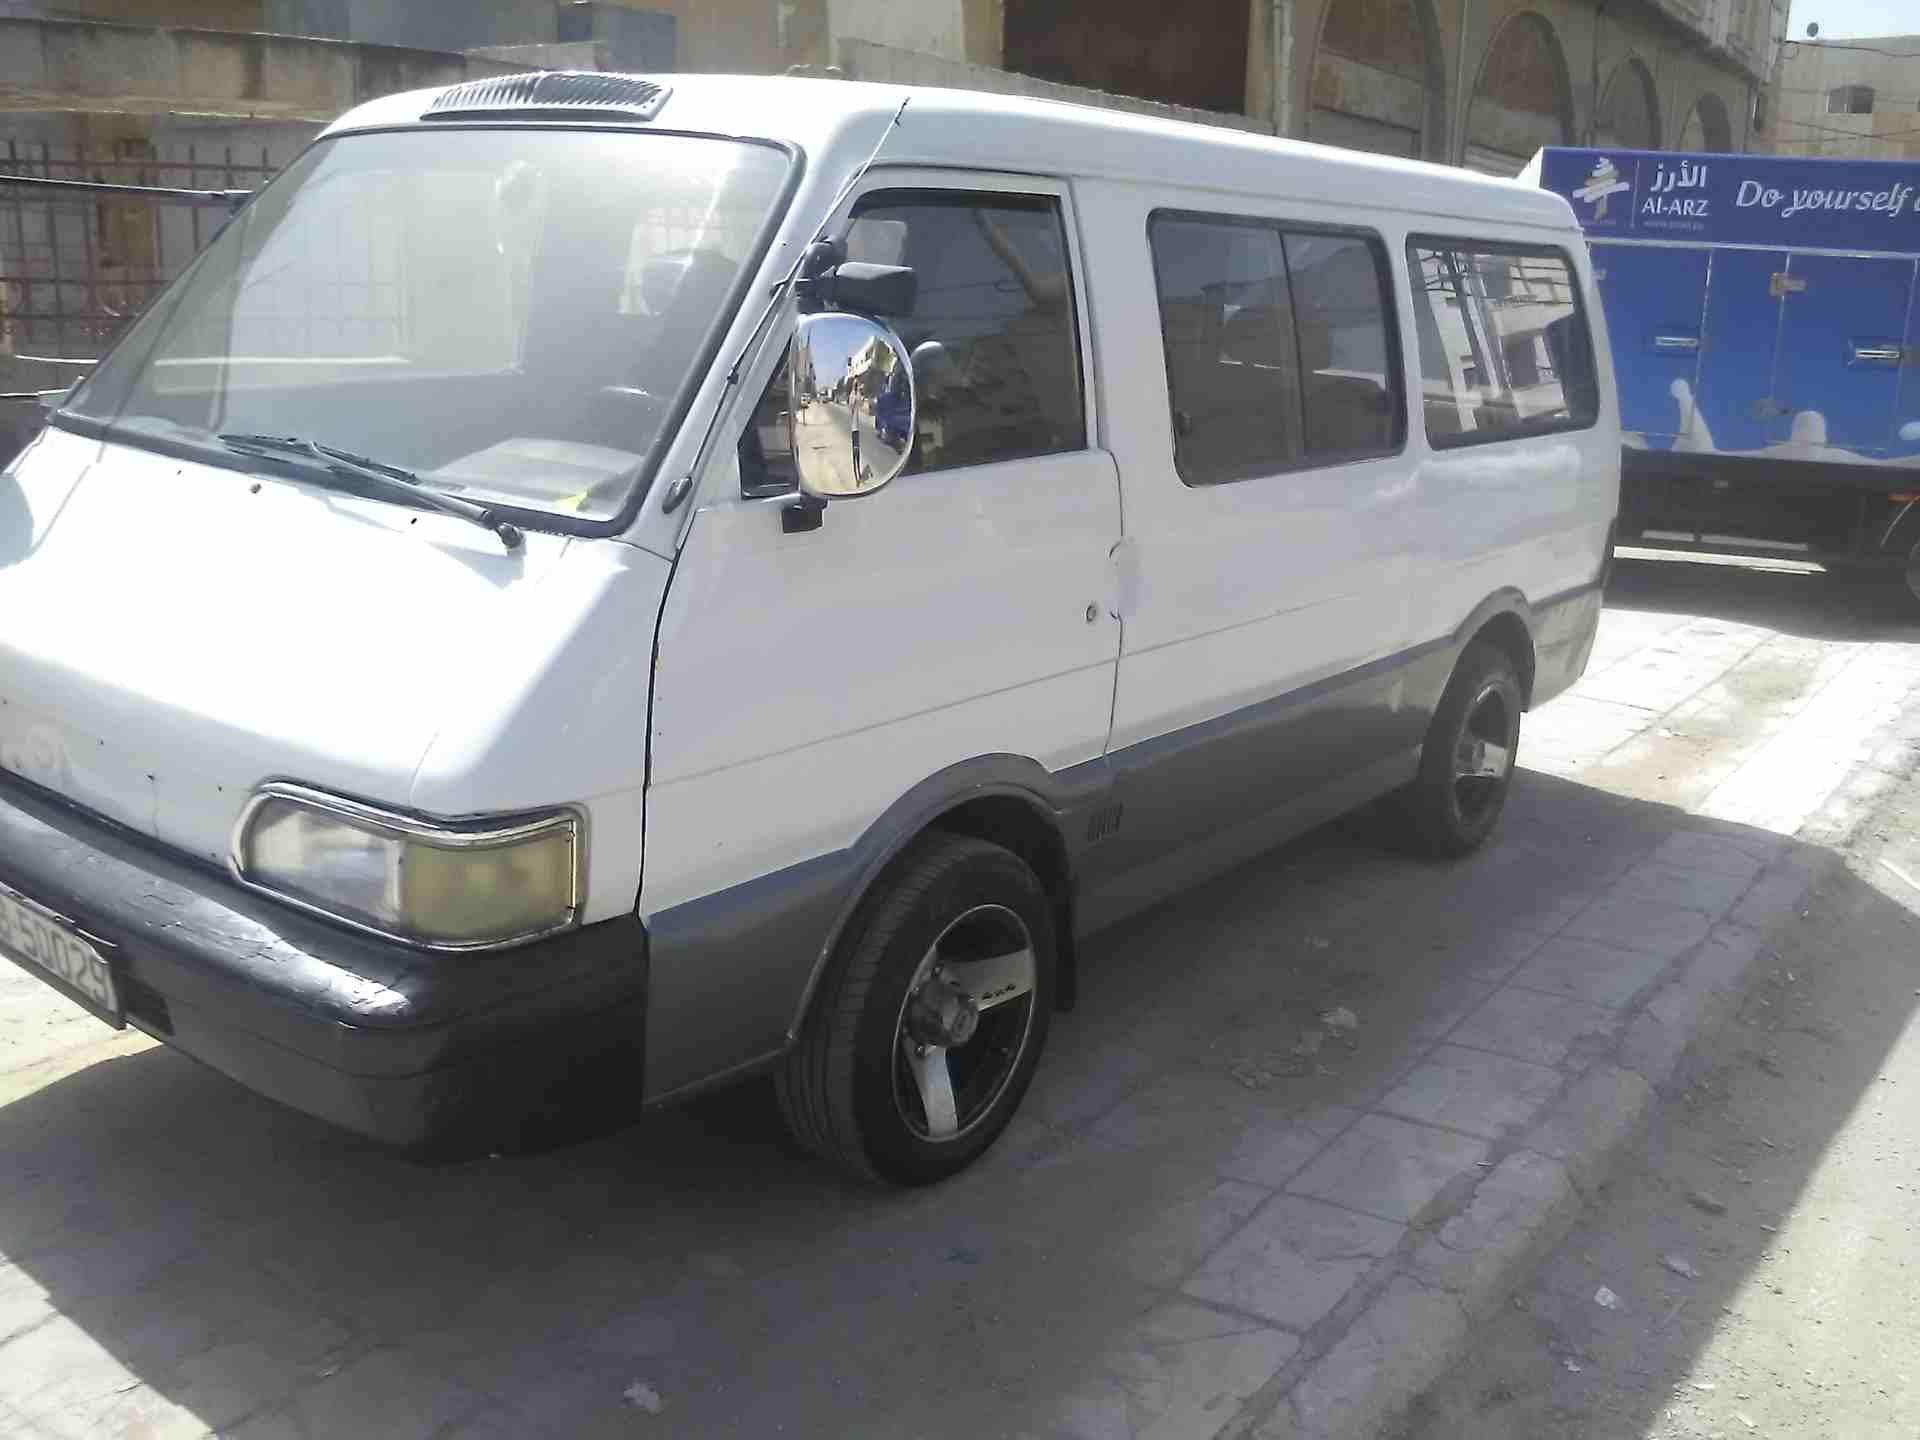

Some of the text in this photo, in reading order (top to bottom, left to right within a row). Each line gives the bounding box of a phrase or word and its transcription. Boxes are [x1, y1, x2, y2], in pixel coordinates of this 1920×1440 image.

[1650, 160, 1707, 192] الأرز
[1735, 180, 1784, 208] Do
[1780, 182, 1913, 218] yourself
